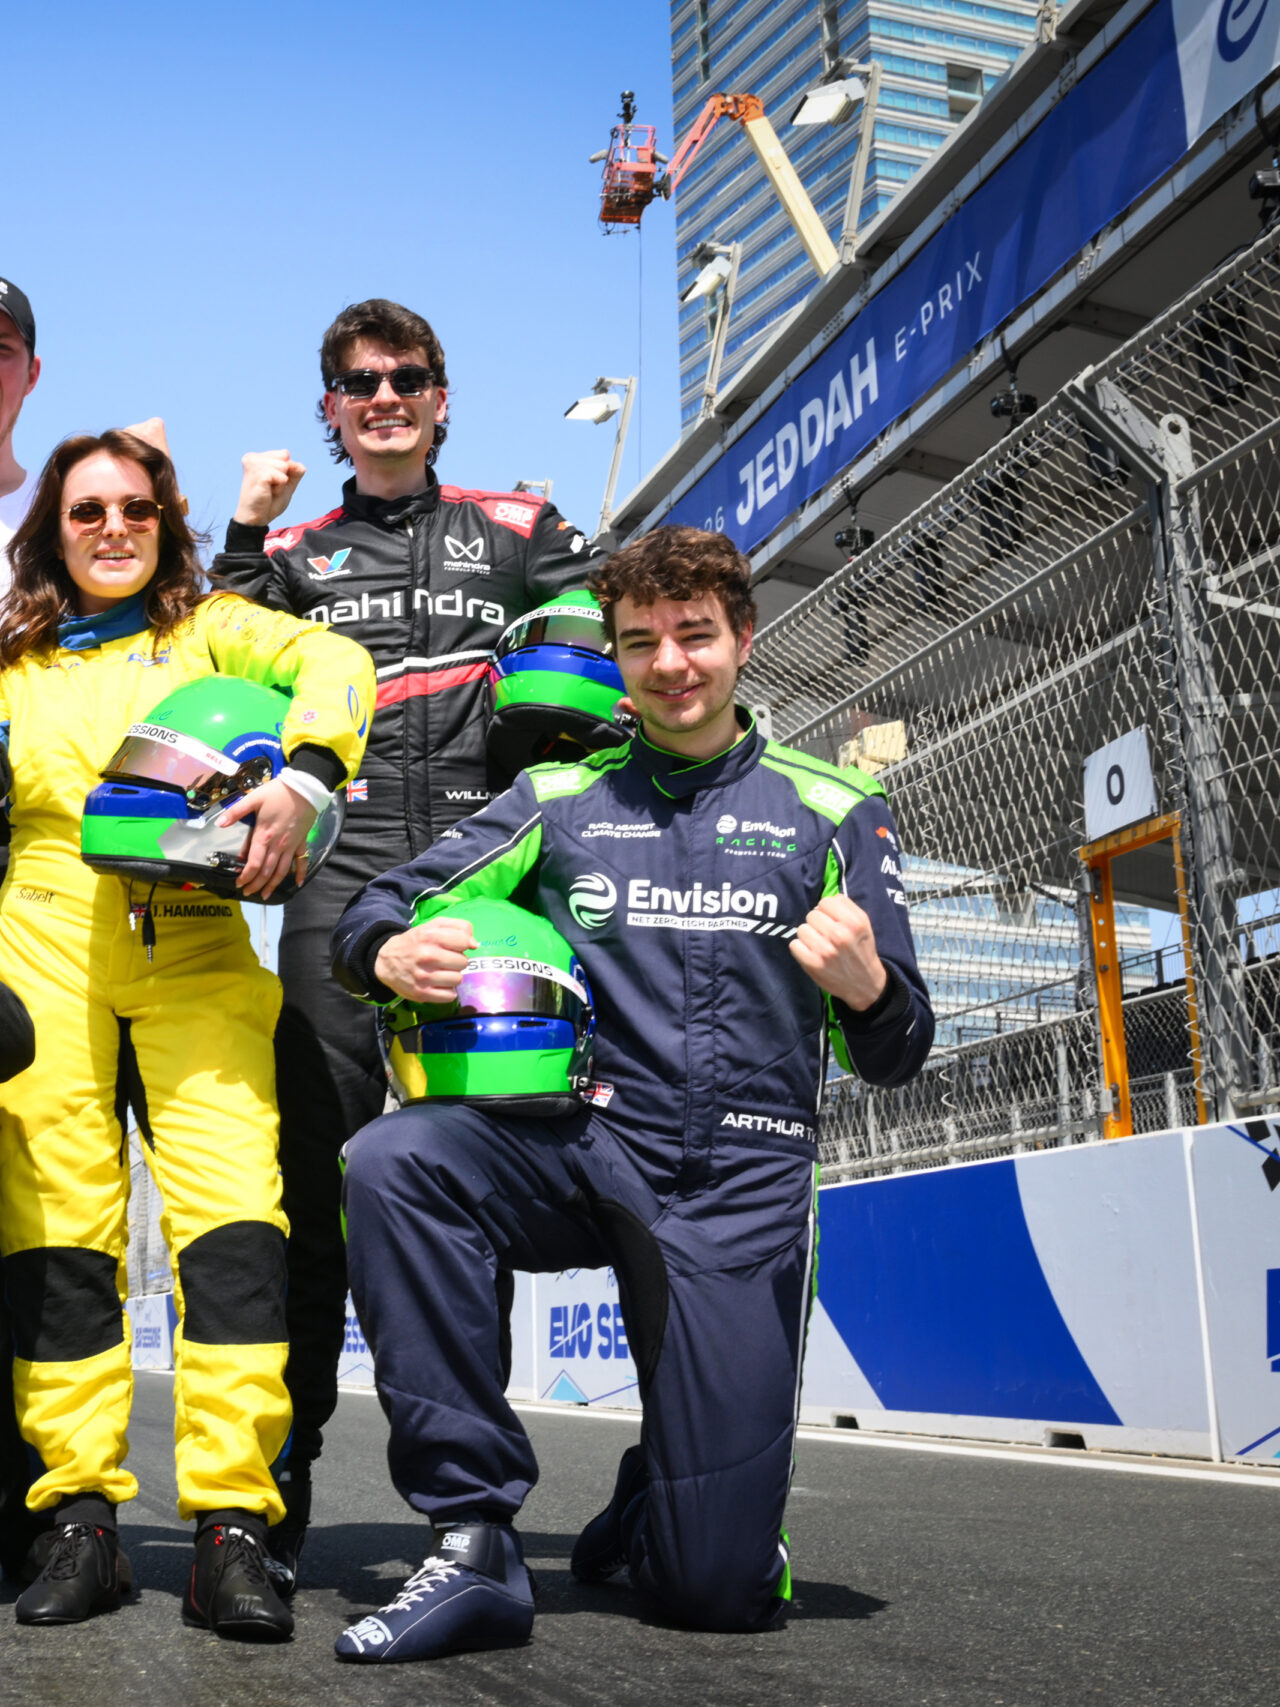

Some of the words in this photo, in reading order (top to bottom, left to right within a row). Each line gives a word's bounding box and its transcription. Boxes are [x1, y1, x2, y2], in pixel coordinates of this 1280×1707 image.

[736, 337, 879, 526] JEDDAH
[894, 250, 982, 362] E-PRIX
[1106, 764, 1125, 806] 0
[741, 820, 796, 838] Envision
[627, 879, 778, 918] Envision
[631, 916, 650, 924] NET
[653, 917, 678, 925] ZERO
[682, 919, 705, 928] TECH
[708, 919, 749, 928] PARTNER
[469, 960, 554, 977] SESSIONS
[721, 1112, 804, 1138] ARTHUR
[441, 1535, 470, 1549] OMP
